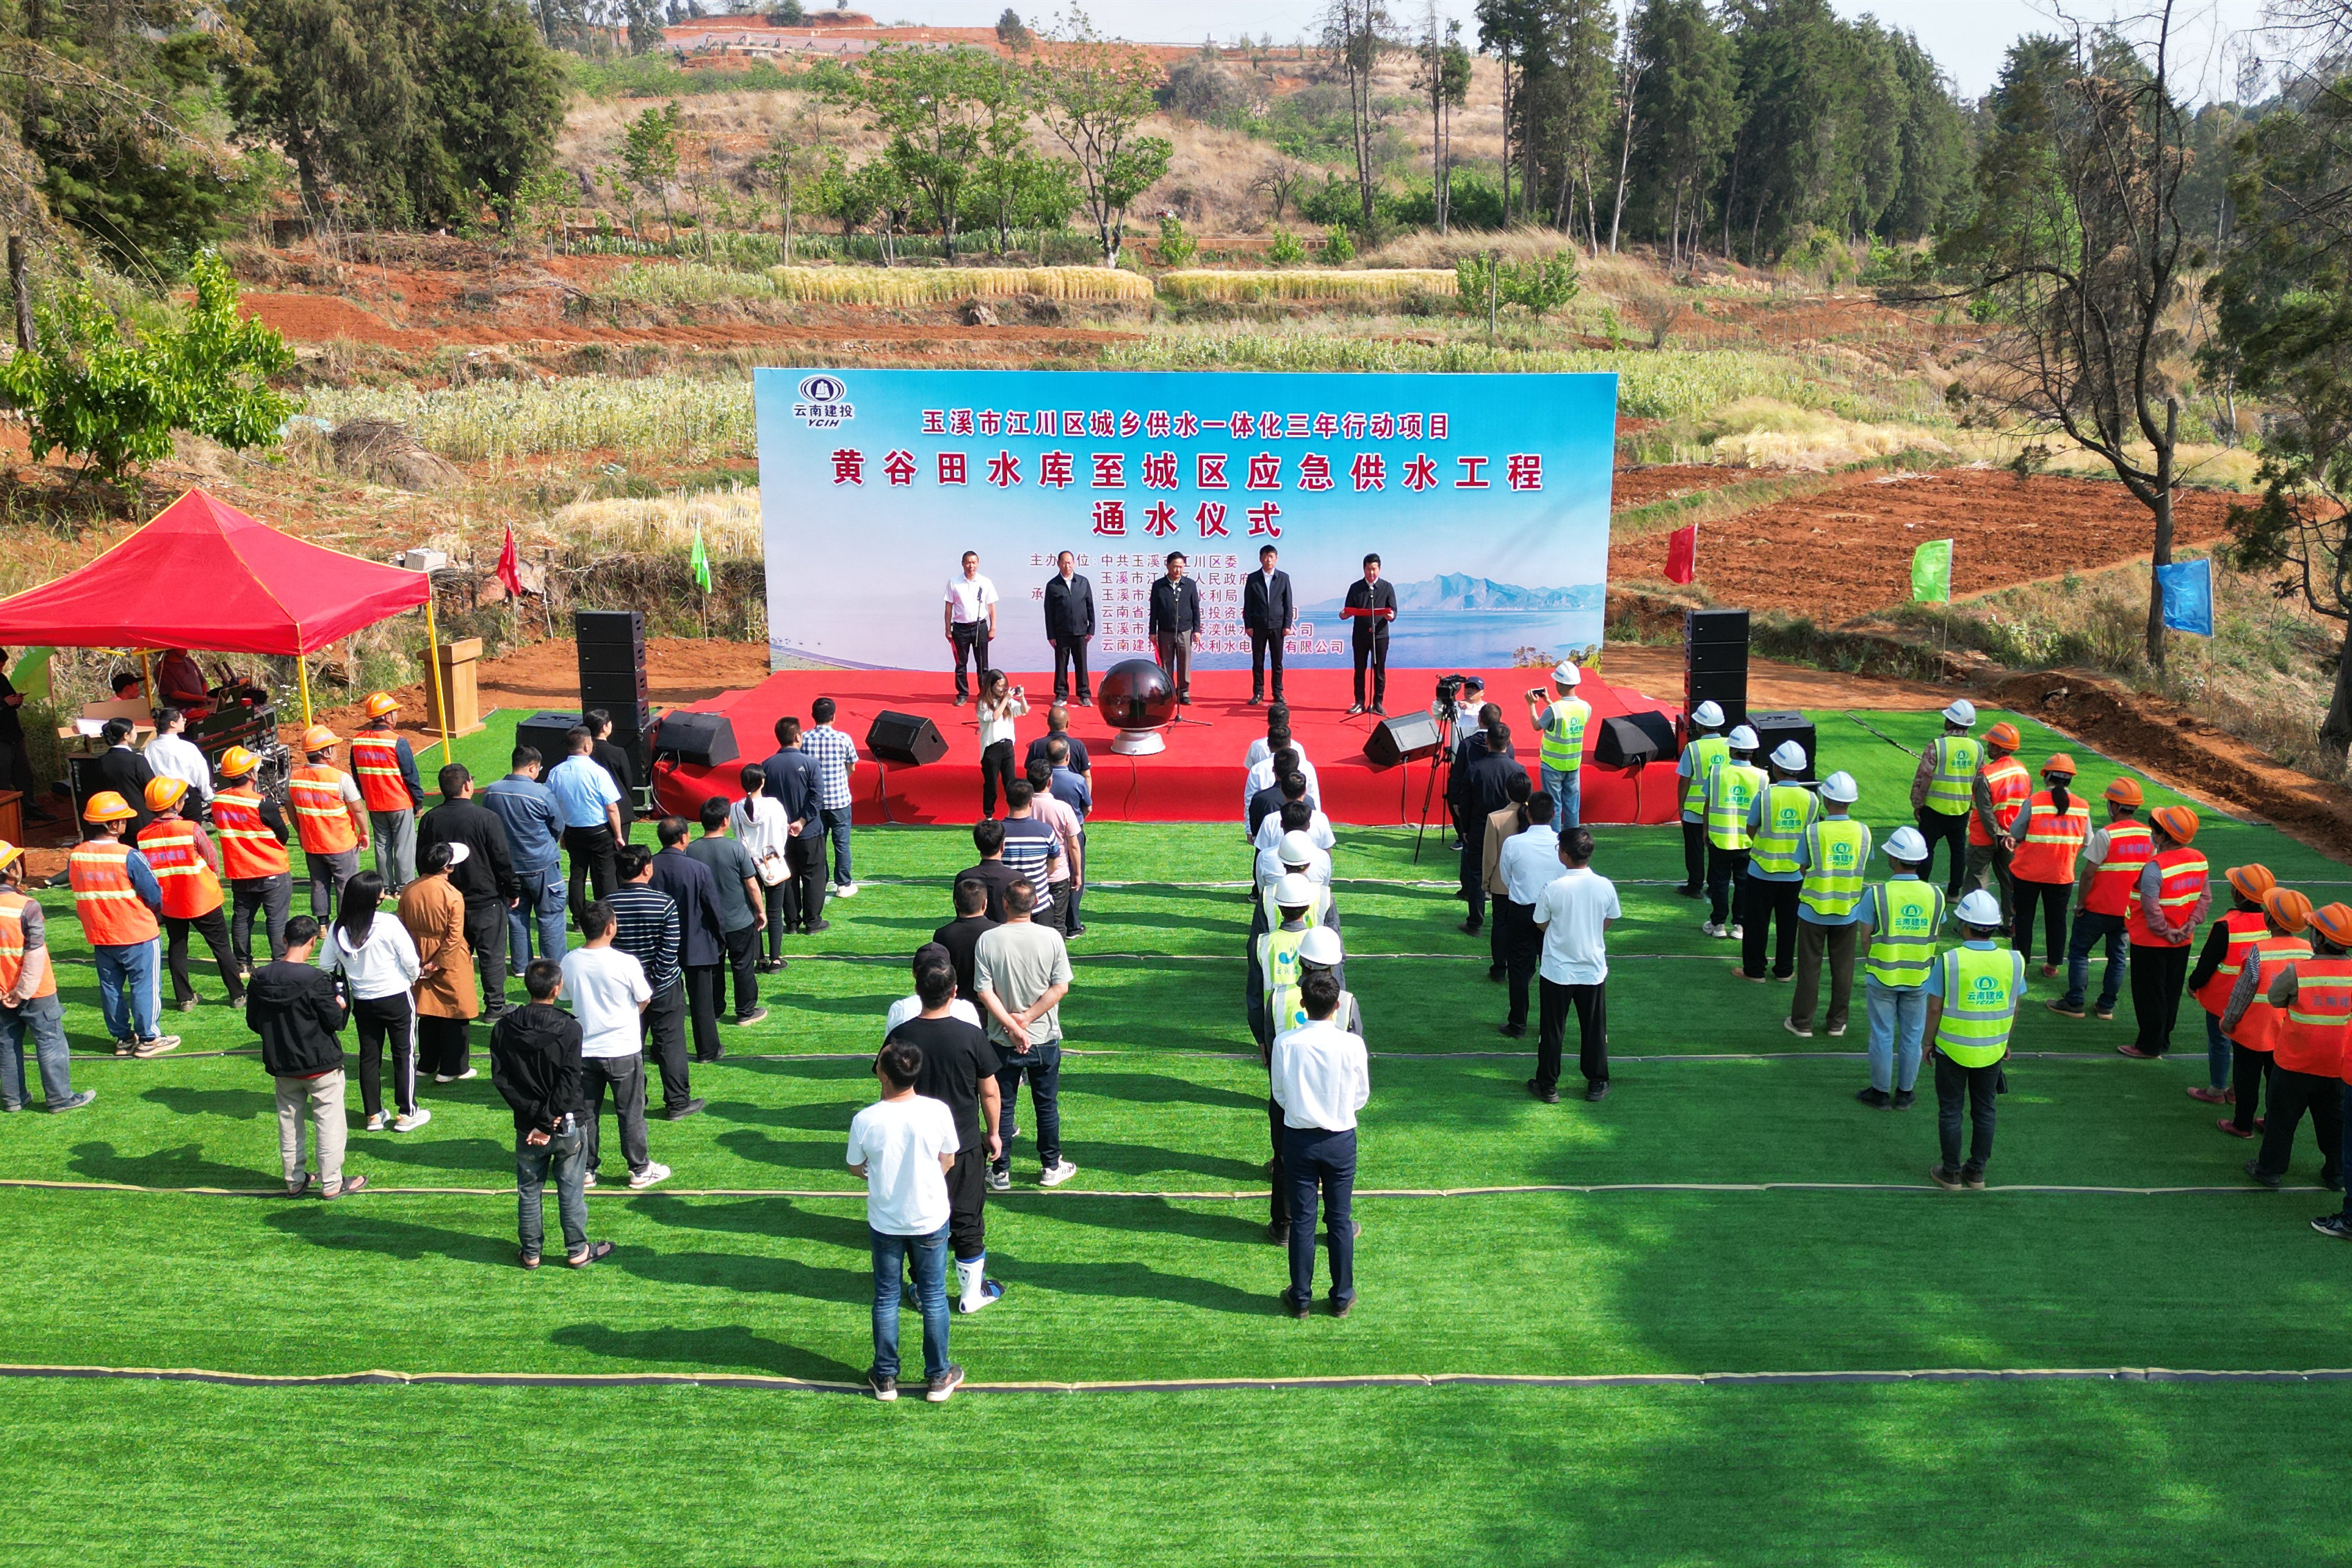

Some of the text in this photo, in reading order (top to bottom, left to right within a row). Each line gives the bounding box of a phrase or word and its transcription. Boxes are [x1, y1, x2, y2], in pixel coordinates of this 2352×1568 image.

[794, 404, 852, 417] 云南建投
[922, 411, 1448, 438] 玉溪市江川区城乡供水一体化三年行动项目
[832, 449, 1542, 490] 黄谷田水库至城区应急供水工程
[1092, 501, 1281, 537] 通水仪式
[1967, 991, 2004, 1000] 云南建投
